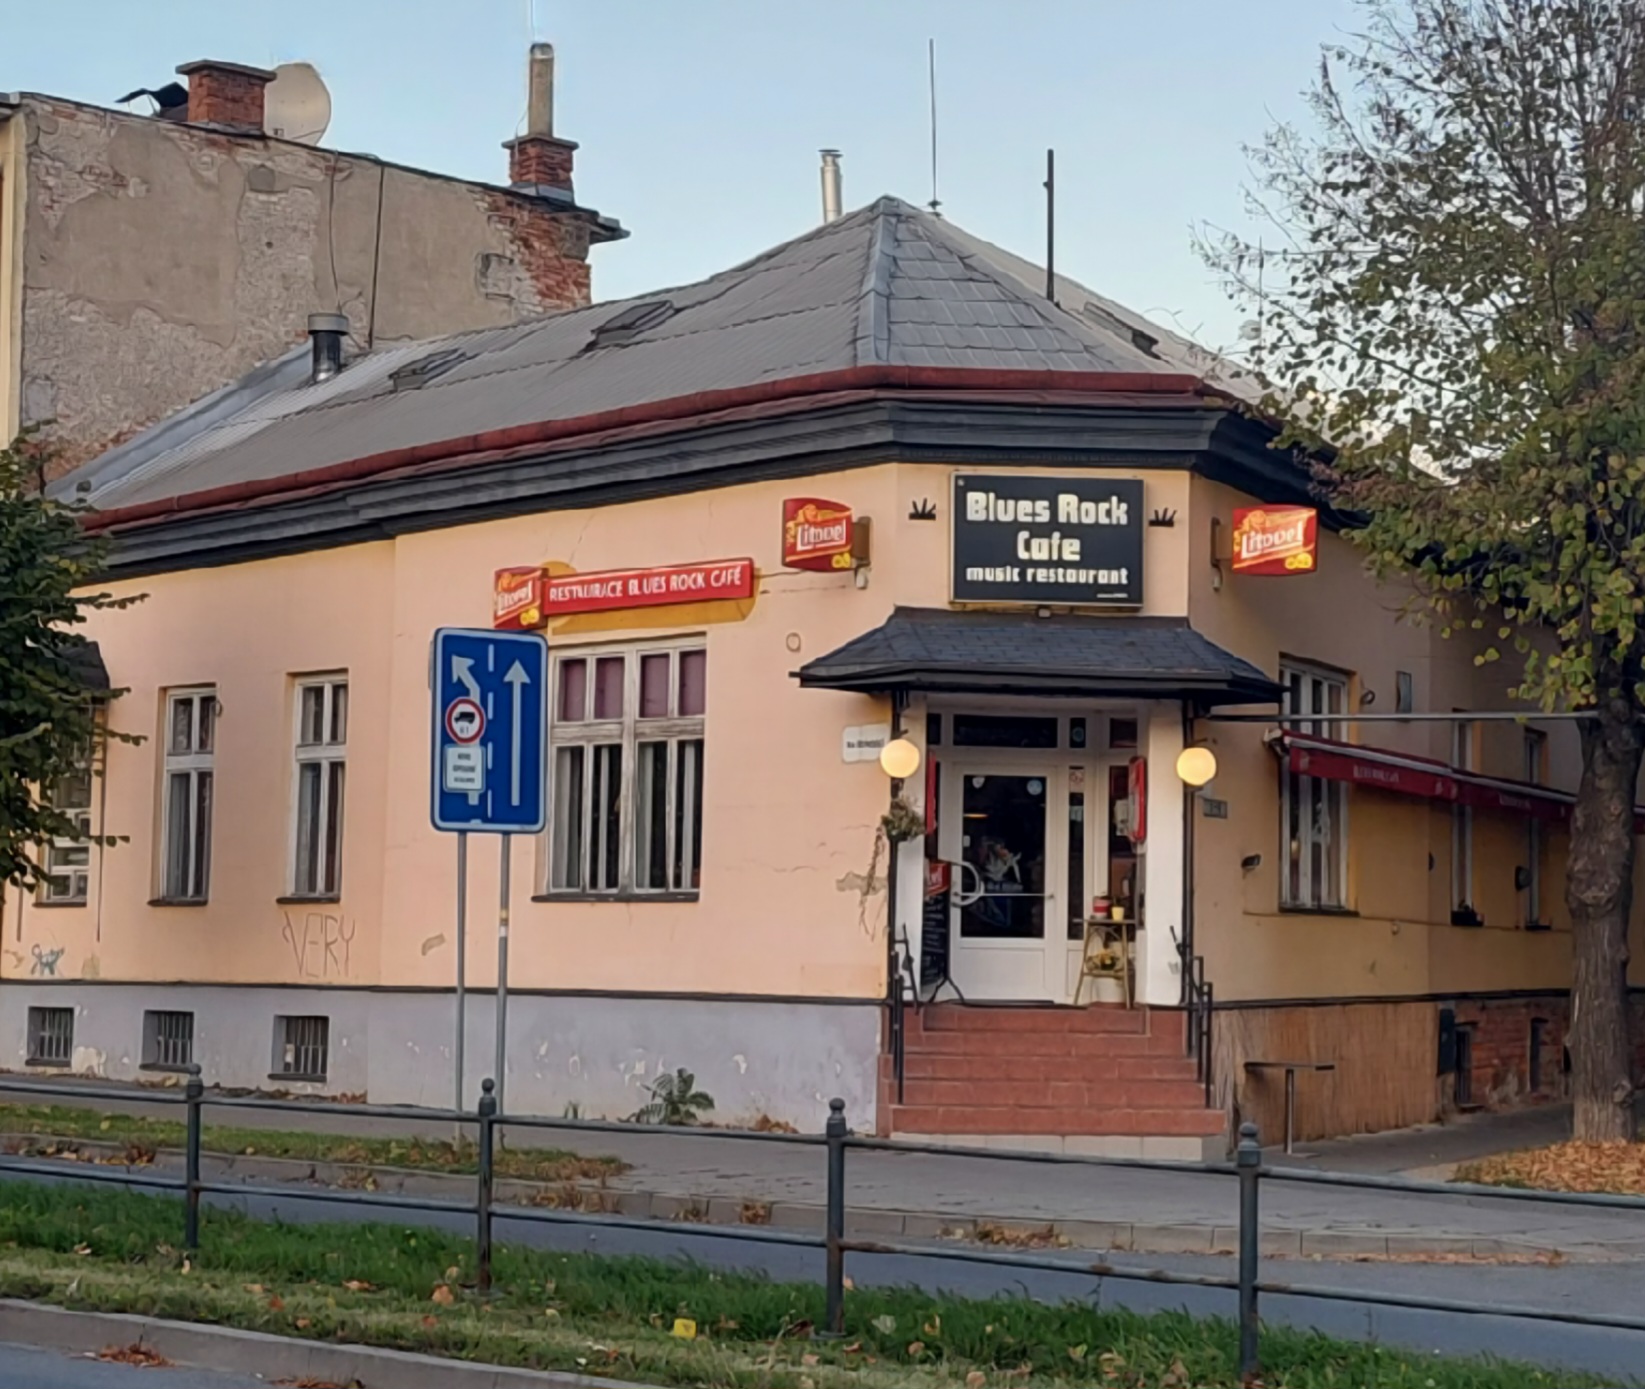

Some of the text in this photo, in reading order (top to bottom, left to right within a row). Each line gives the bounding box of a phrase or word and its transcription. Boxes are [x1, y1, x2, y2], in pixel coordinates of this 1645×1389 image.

[966, 491, 1128, 525] Blues Rock
[1017, 530, 1081, 561] Cafe
[1241, 519, 1303, 560] Litovel
[549, 564, 742, 602] RESTAURACE BLUES ROCK CAFÉ
[965, 565, 1128, 585] music restaurant
